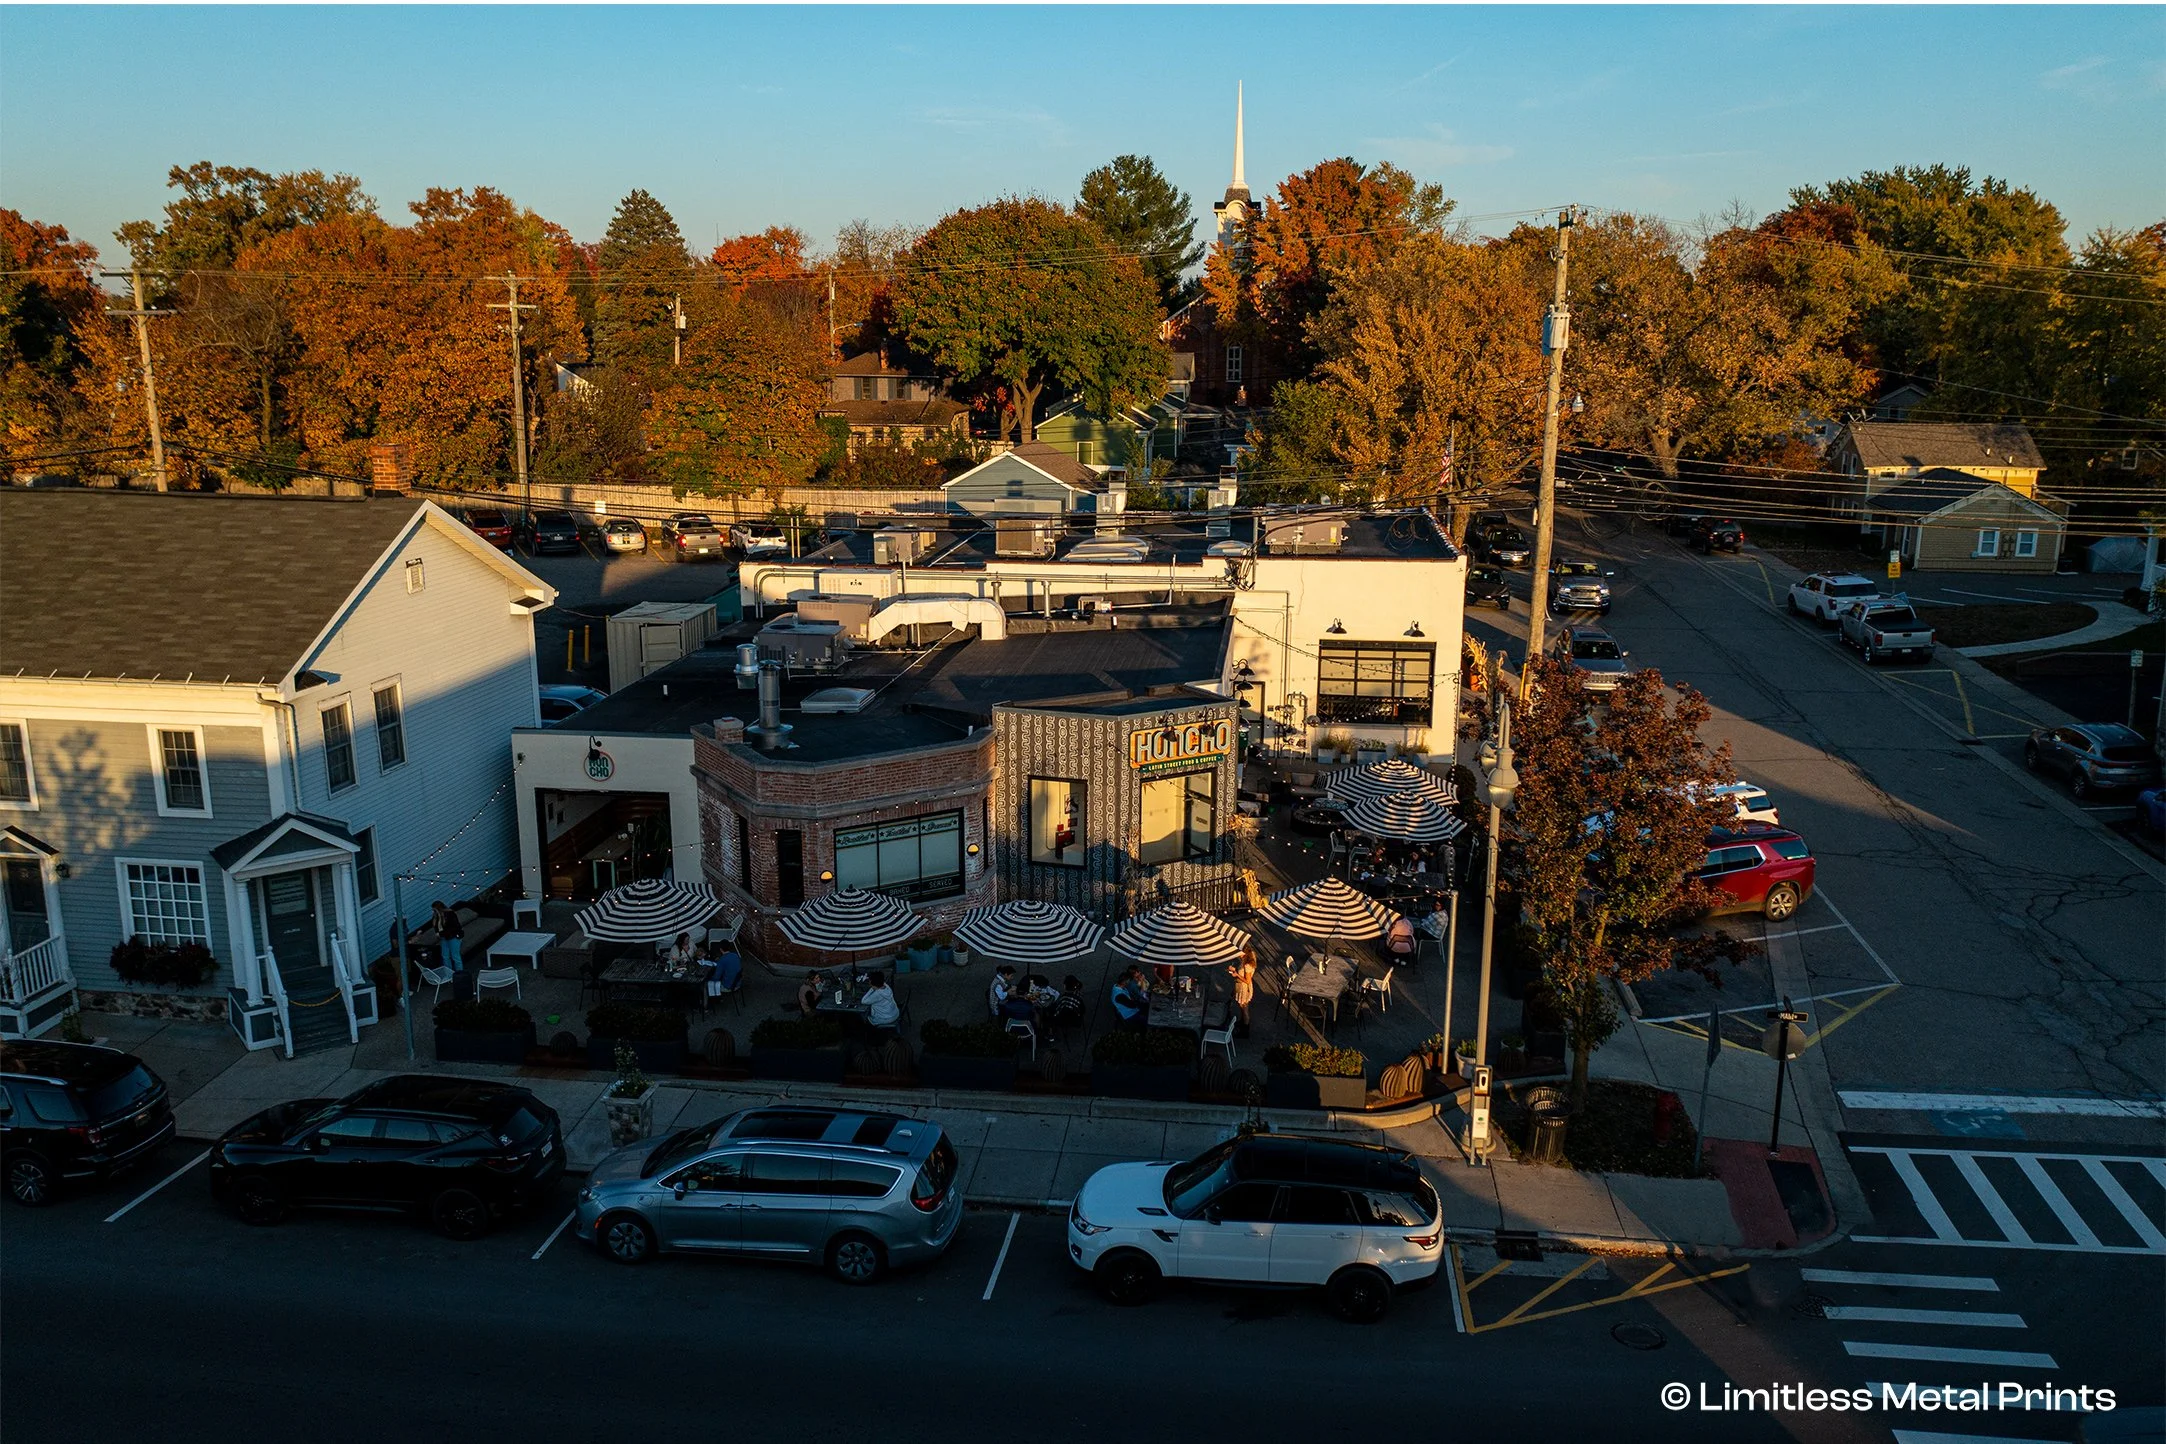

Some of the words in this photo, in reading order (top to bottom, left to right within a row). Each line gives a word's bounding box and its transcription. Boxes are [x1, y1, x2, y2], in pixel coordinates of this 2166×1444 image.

[1136, 722, 1231, 762] HONCHO
[1148, 763, 1163, 771] LATIN
[1164, 760, 1182, 769] STREET
[1182, 758, 1195, 766] FOOD
[1200, 755, 1217, 764] COFFEE
[589, 766, 609, 777] CHO
